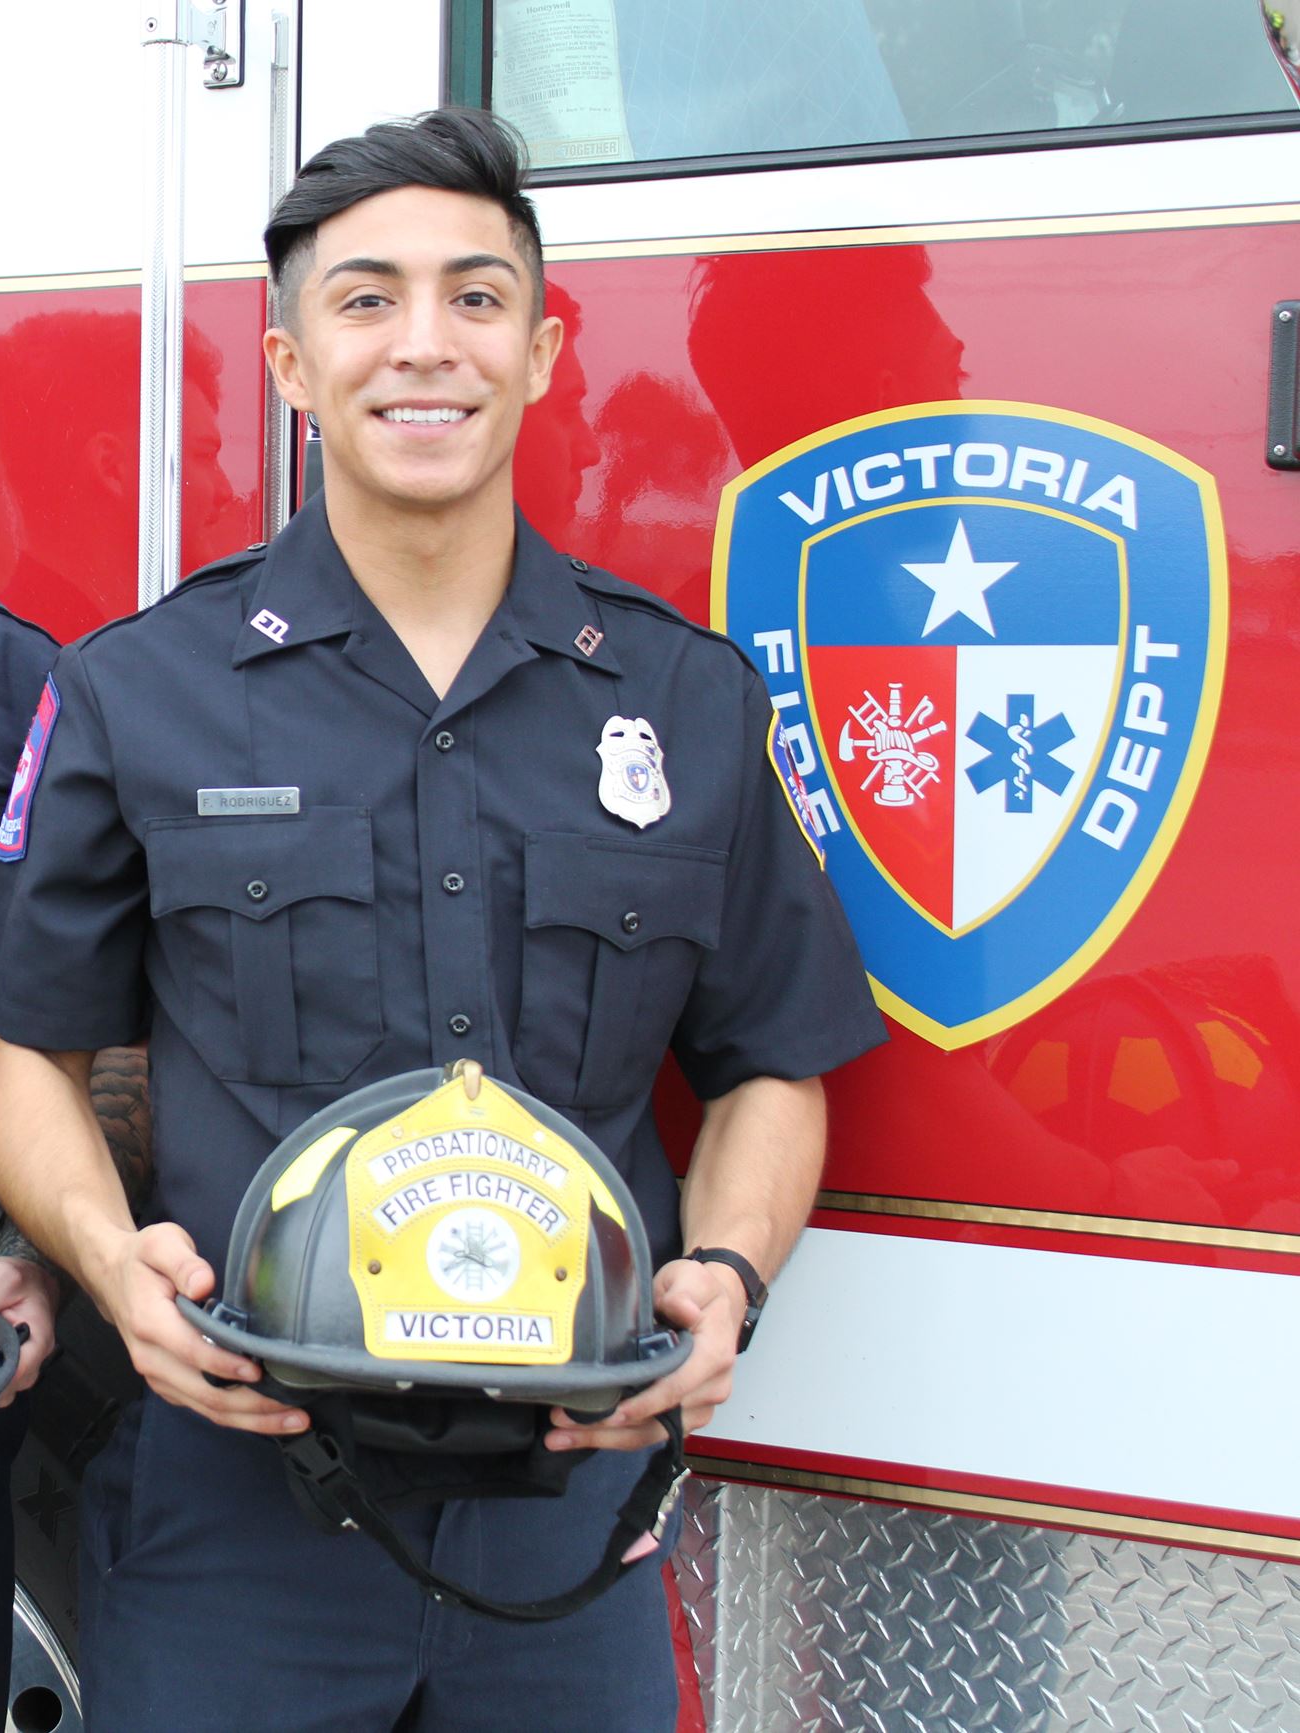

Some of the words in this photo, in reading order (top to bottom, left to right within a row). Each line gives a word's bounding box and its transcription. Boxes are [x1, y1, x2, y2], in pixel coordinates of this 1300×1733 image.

[526, 1, 571, 15] Honeywell
[564, 141, 617, 156] TOGETHER
[778, 442, 1138, 530] VICTORIA
[1081, 625, 1180, 851] DEPT
[220, 795, 292, 808] RODRIGUEZ
[383, 1130, 556, 1178] PROBATIONARY
[380, 1179, 441, 1227] FIRE
[450, 1173, 560, 1233] FIGHTER
[399, 1314, 543, 1343] VICTORIA
